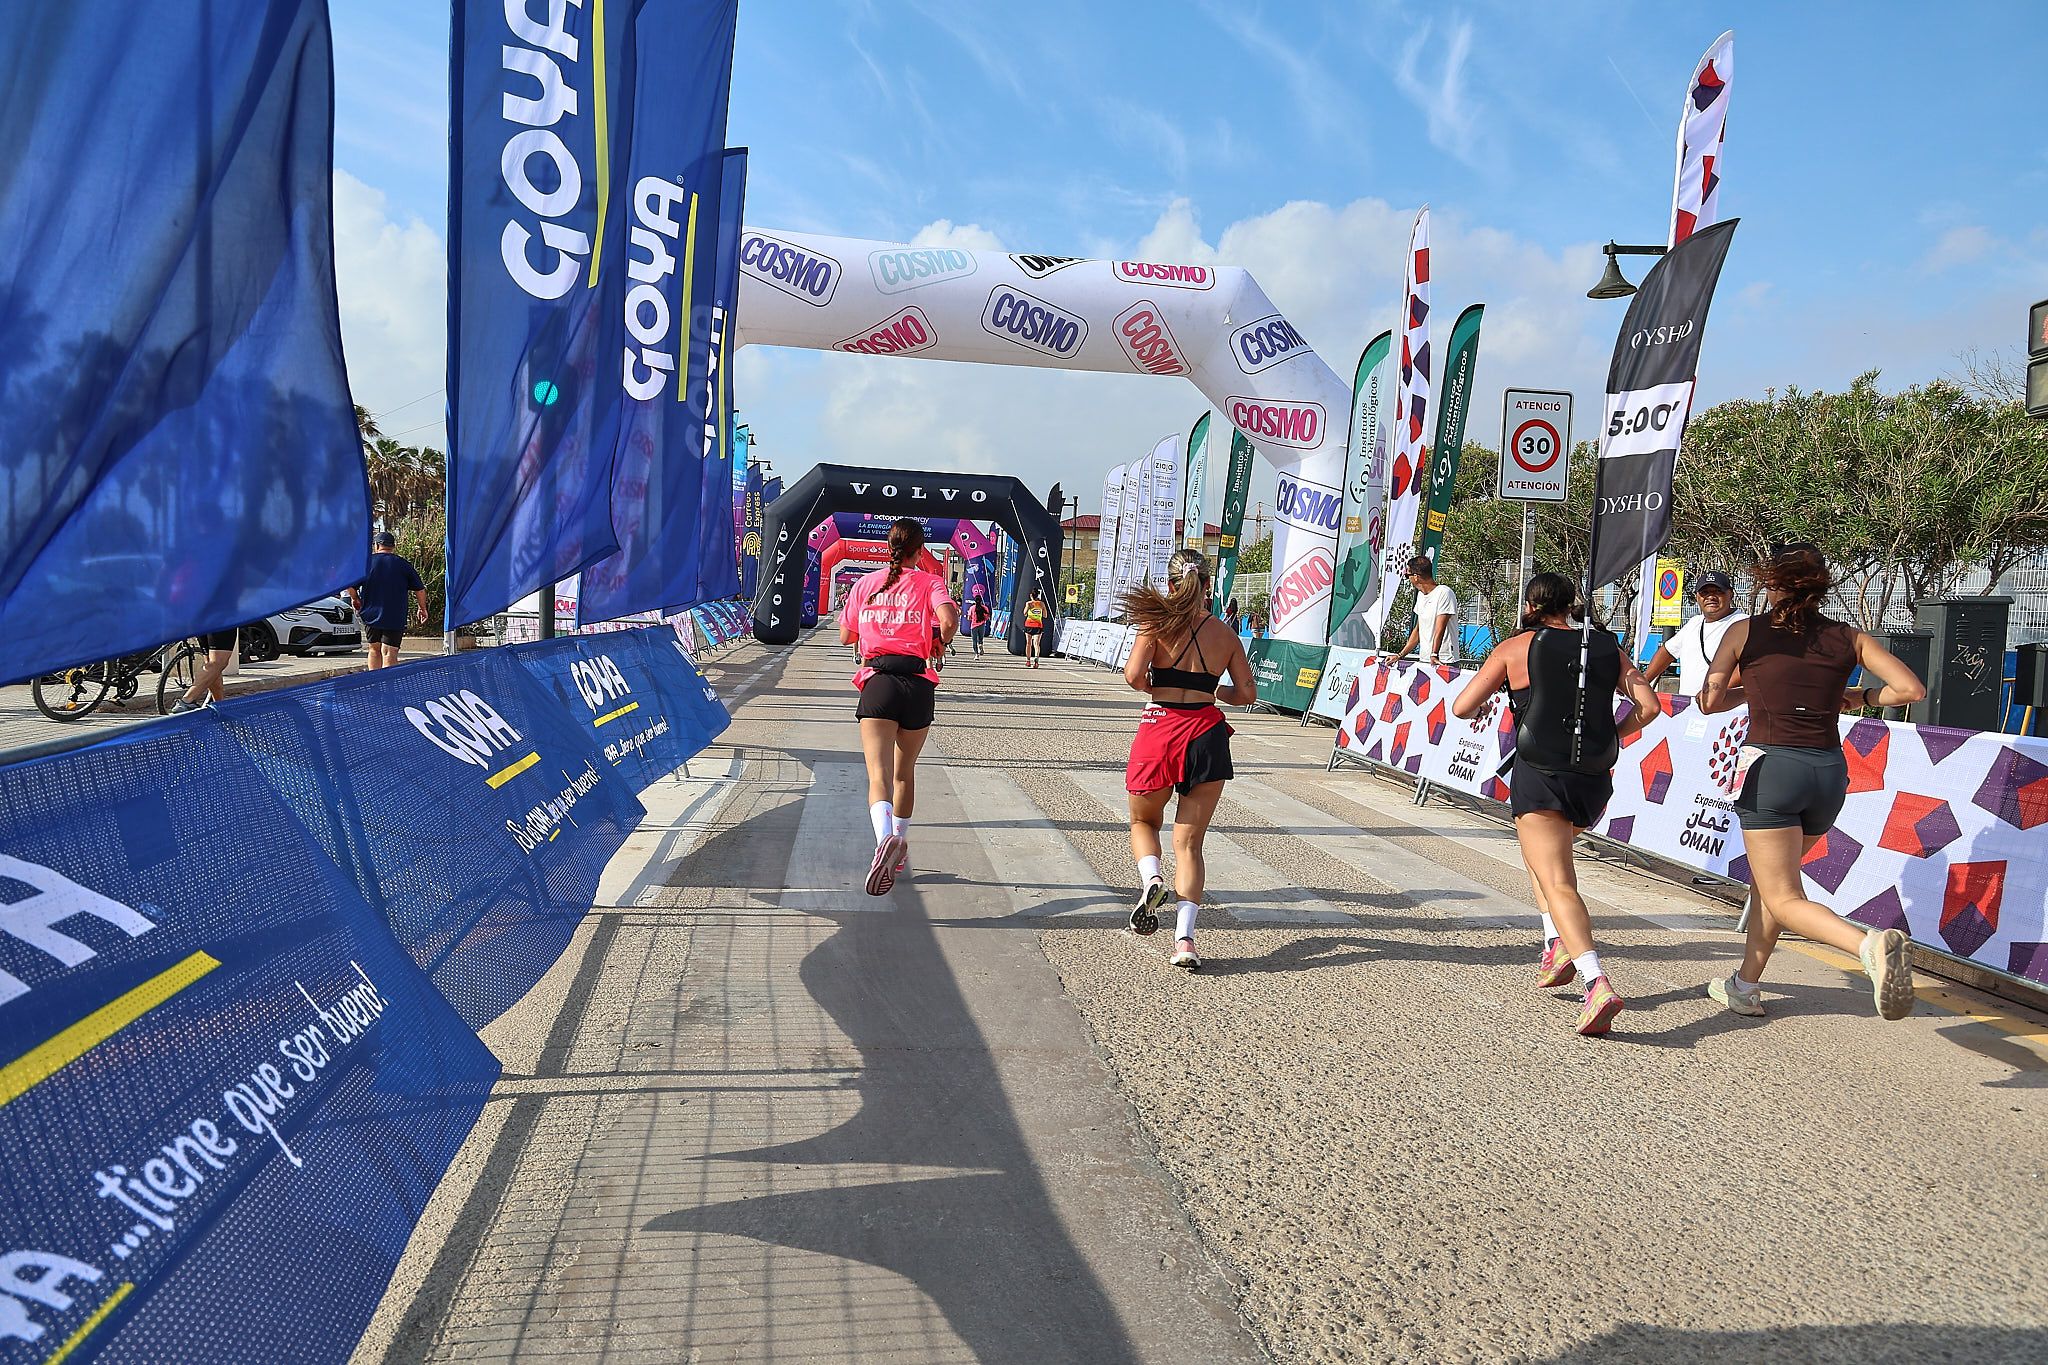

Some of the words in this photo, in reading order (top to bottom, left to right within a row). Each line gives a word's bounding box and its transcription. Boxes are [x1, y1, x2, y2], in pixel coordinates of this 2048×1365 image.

[741, 237, 832, 297] COSMO
[878, 249, 968, 286] COSMO
[1121, 261, 1206, 284] COSMO
[623, 176, 685, 401] GOYA
[991, 293, 1079, 353] COSMO
[1240, 319, 1307, 366] COSM
[1233, 402, 1317, 442] COSMO
[1515, 400, 1561, 412] ATENCIÓ
[1359, 402, 1368, 458] Institutos
[1521, 436, 1551, 455] 30
[850, 482, 987, 503] VOLVO
[1276, 478, 1343, 531] COSMO
[1507, 480, 1561, 492] ATENCIÓN
[770, 530, 789, 629] VOLVO
[1270, 554, 1334, 625] COSMO
[859, 609, 922, 624] MPARABLES
[404, 689, 523, 771] GOYA
[1458, 737, 1485, 751] Experience
[1448, 763, 1476, 782] OMAN
[1694, 793, 1735, 813] Experience
[1679, 829, 1725, 858] OMAN
[278, 1023, 331, 1083] ser
